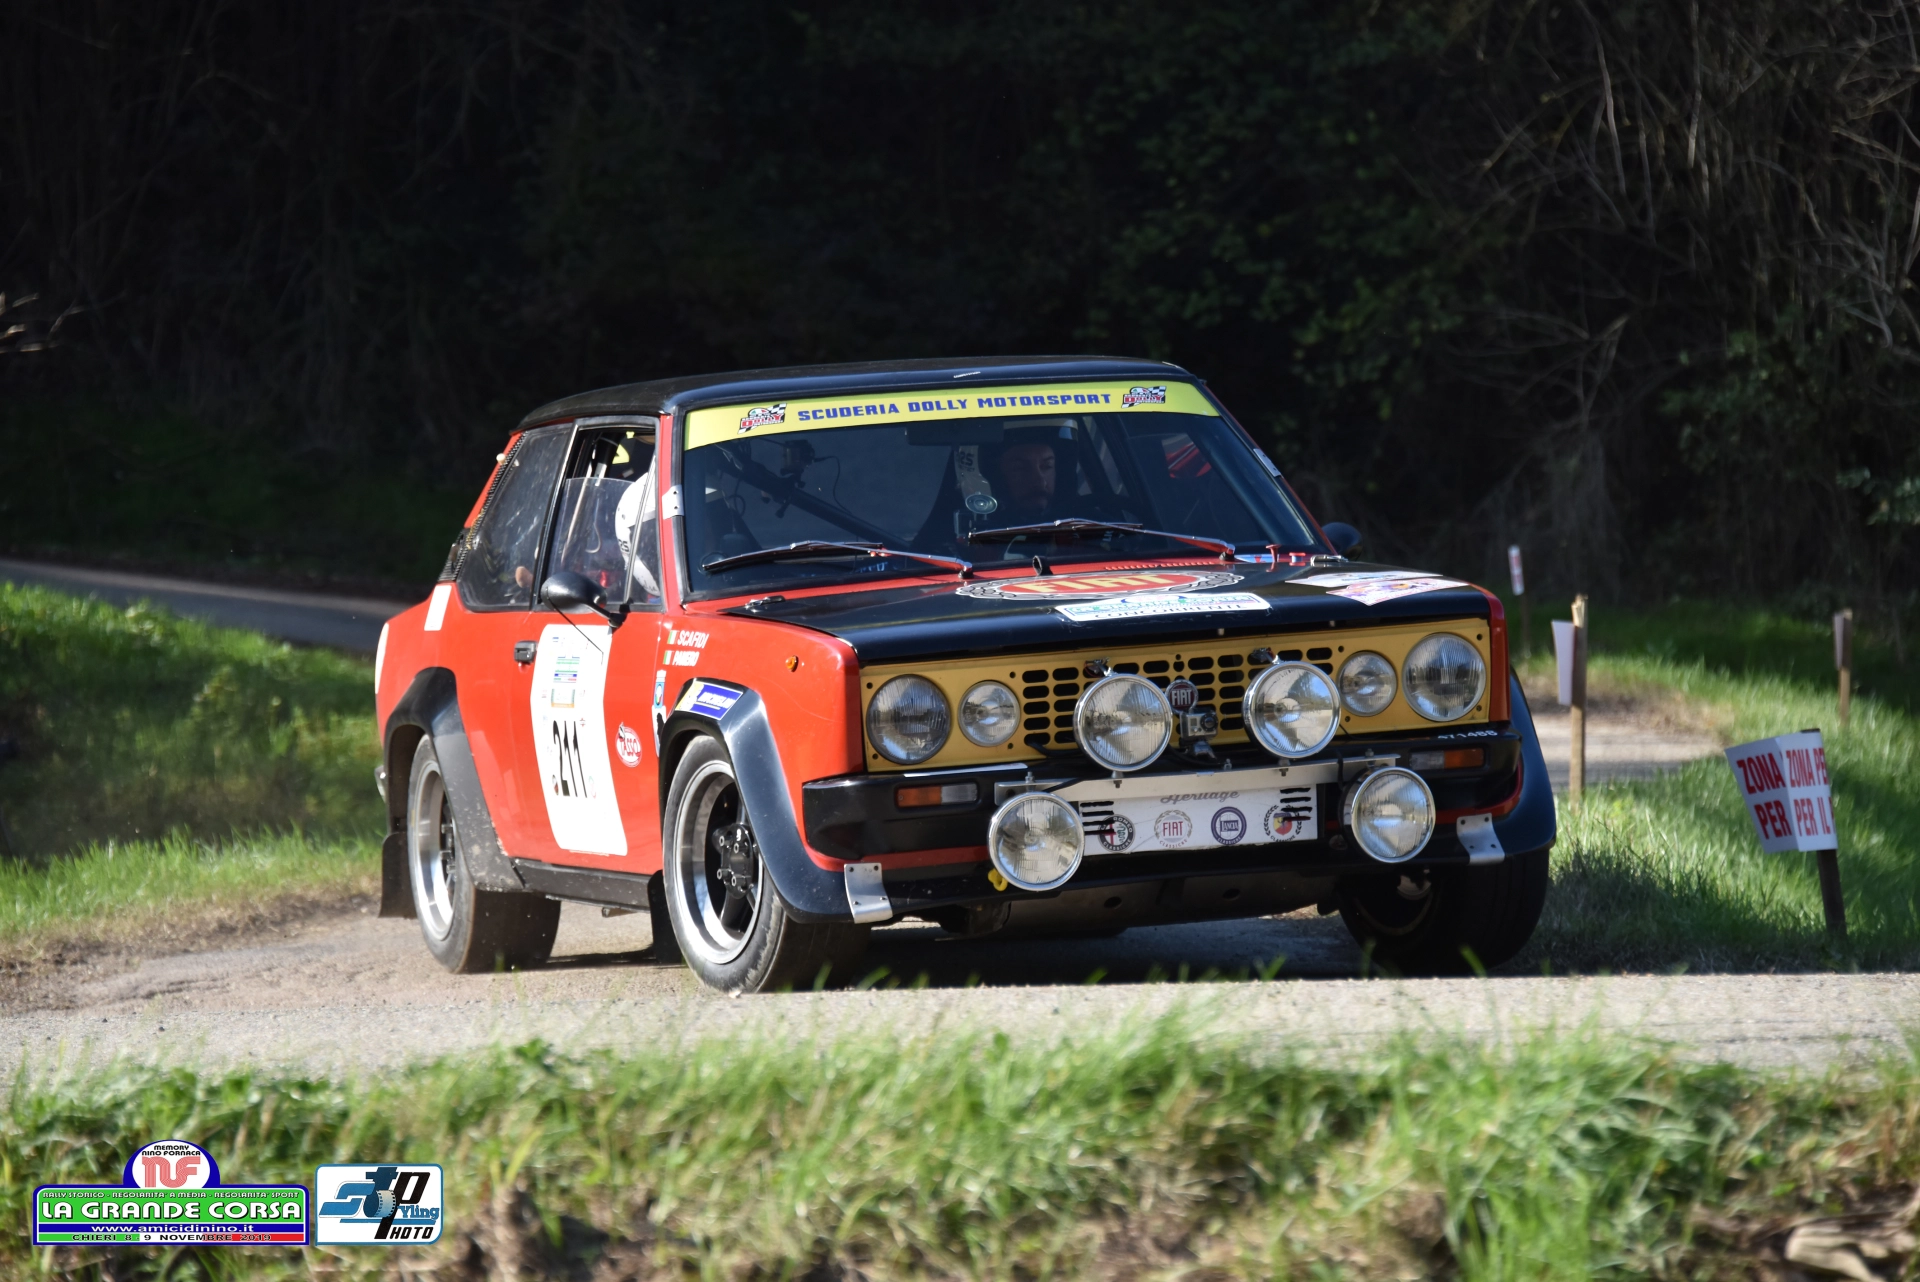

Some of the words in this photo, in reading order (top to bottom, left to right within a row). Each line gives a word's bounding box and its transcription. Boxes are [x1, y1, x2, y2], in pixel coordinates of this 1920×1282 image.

[797, 403, 900, 422] SCUDERIA
[907, 398, 968, 413] DOLLY
[978, 393, 1111, 408] MOTORSPORT
[1012, 574, 1177, 593] FIAT
[1171, 689, 1192, 706] FIAT
[552, 720, 587, 798] 211
[1736, 752, 1786, 795] ZONA
[1786, 748, 1816, 788] ZONA
[1162, 821, 1183, 837] FIAT
[1221, 820, 1239, 832] LANCIA
[1753, 800, 1792, 840] PER
[1793, 798, 1818, 837] PER
[1817, 797, 1831, 835] IL
